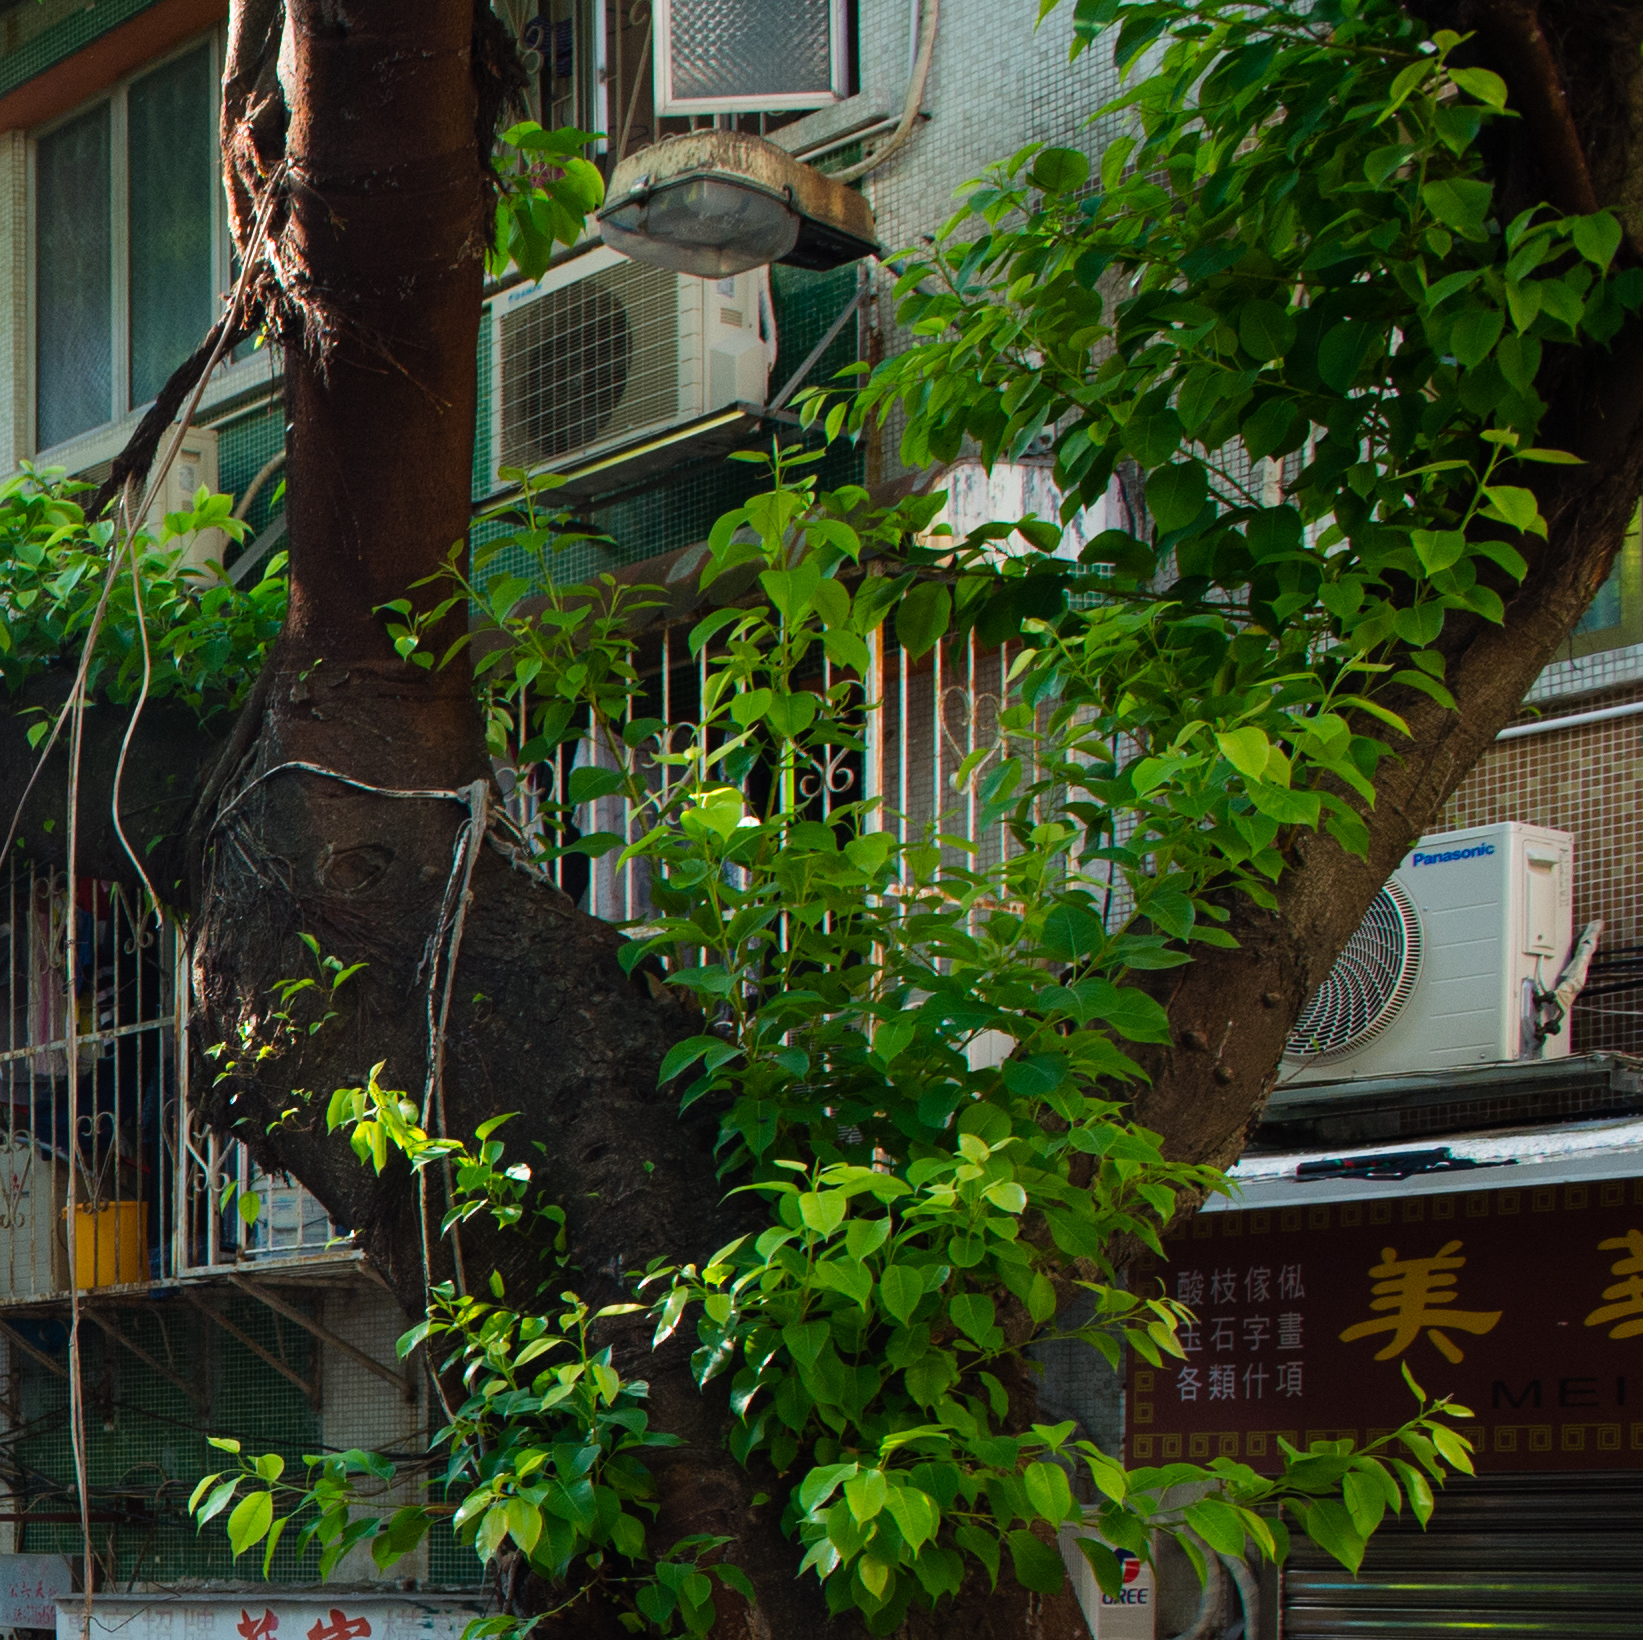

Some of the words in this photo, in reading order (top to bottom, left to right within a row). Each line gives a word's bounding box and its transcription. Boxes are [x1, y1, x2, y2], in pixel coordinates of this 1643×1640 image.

[1412, 842, 1495, 868] Panasonic
[1176, 1263, 1306, 1307] 酸枝傢俬
[1178, 1311, 1305, 1353] 玉石字畫
[1175, 1360, 1305, 1403] 各類什項
